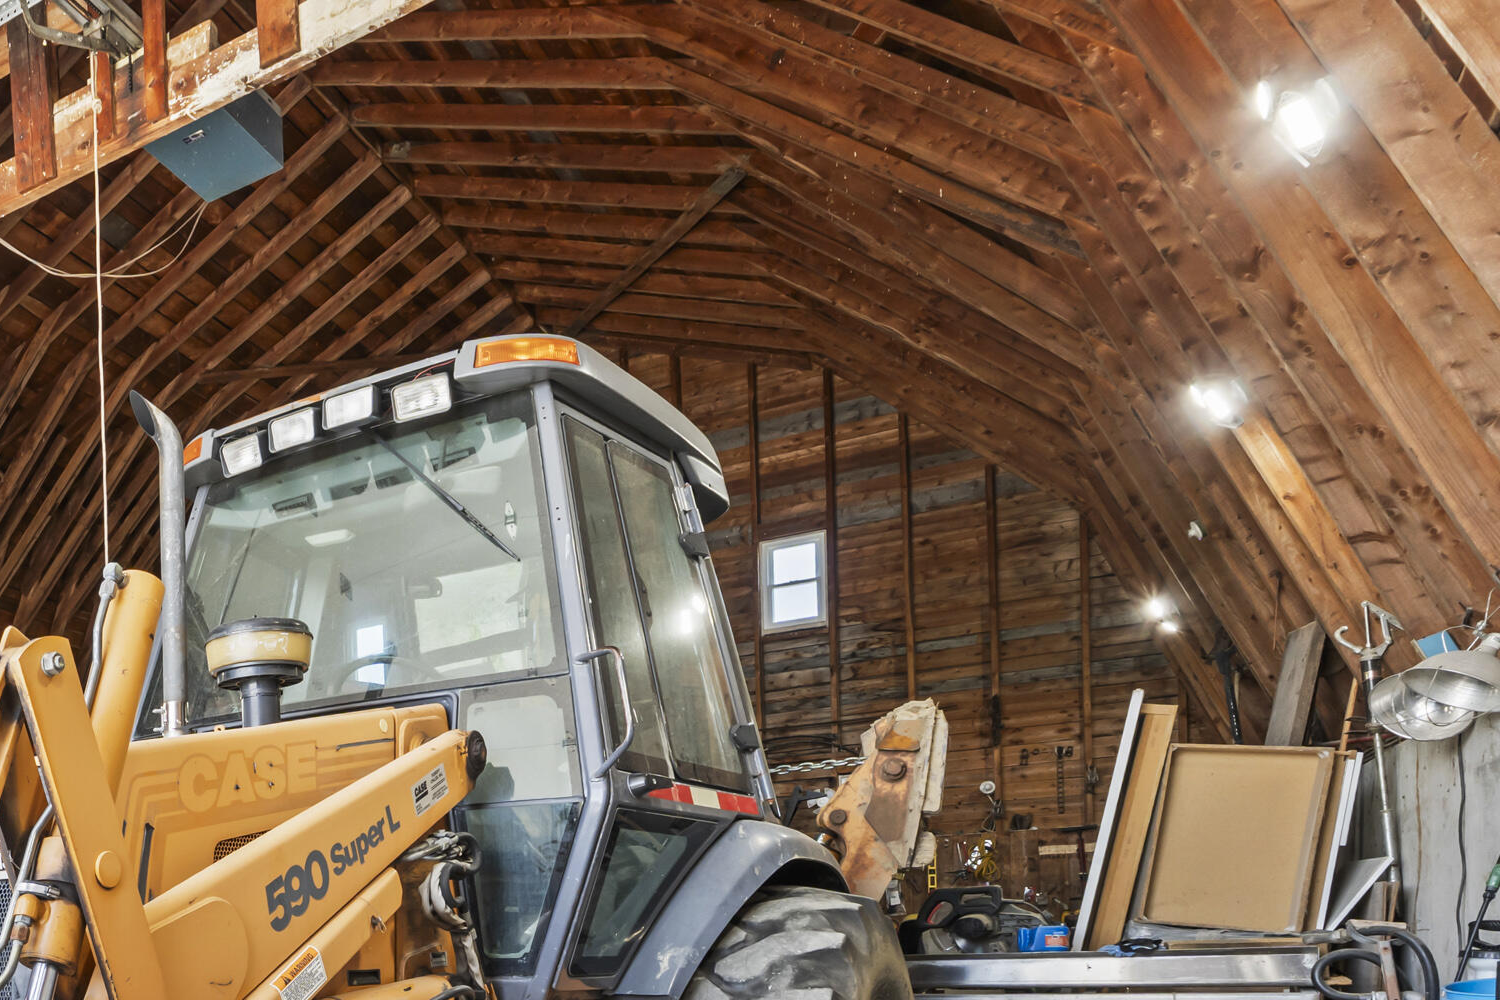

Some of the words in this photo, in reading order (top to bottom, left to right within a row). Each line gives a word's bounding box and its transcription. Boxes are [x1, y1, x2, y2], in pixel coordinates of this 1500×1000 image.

[178, 740, 317, 813] CASE
[415, 780, 428, 797] CASE
[266, 850, 329, 932] 590
[330, 817, 385, 876] Super
[385, 804, 401, 833] L
[289, 952, 315, 977] WARNING
